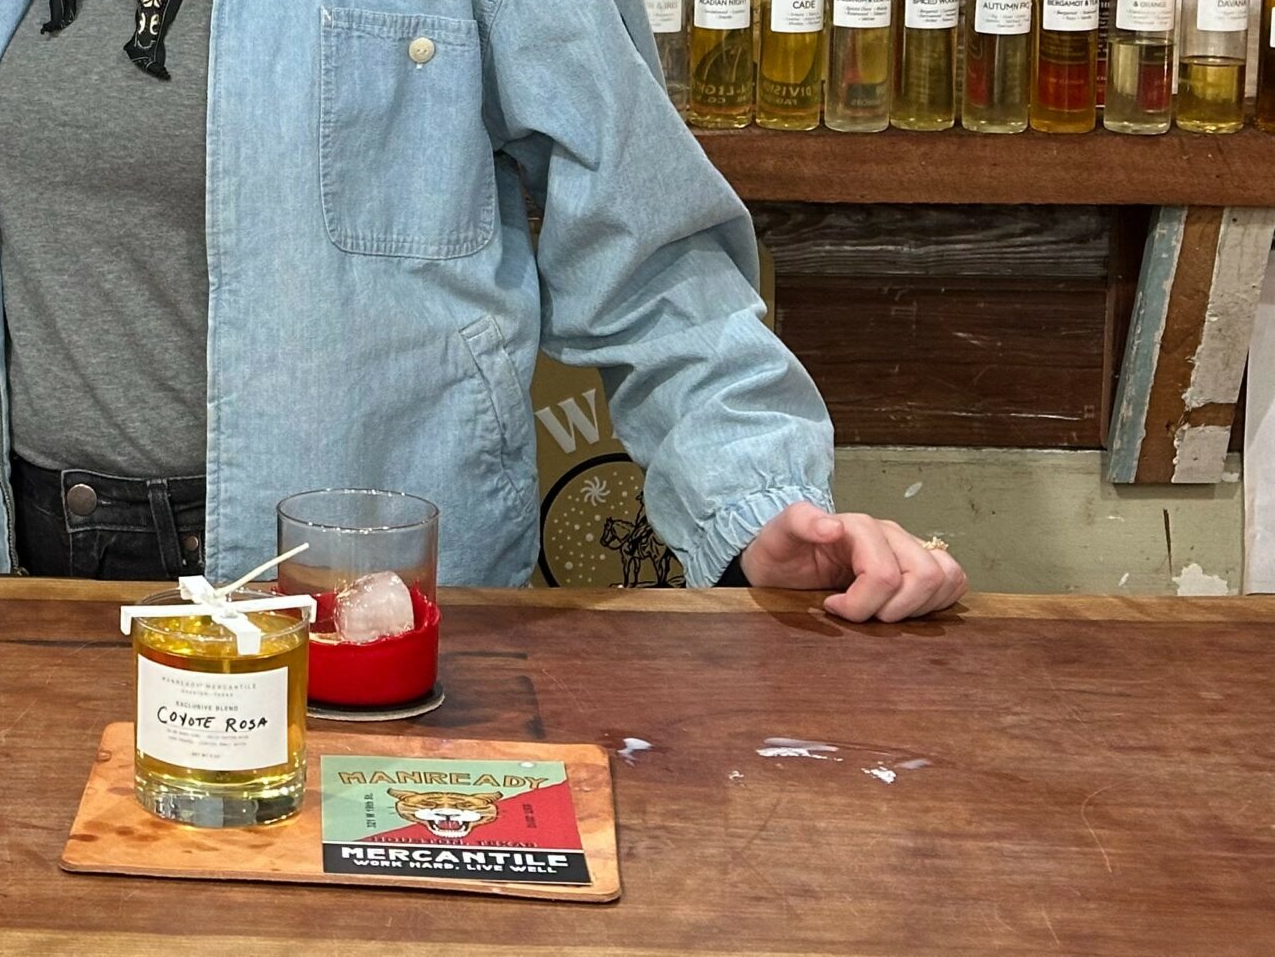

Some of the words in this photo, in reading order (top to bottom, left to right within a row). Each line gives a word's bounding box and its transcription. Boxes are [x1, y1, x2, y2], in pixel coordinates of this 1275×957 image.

[792, 0, 816, 10] CADE
[982, 2, 1019, 11] AUTUMN
[1046, 0, 1084, 7] BERGAMOT
[225, 717, 268, 733] ROSA
[338, 771, 550, 790] MANREADY
[340, 846, 570, 868] MERCANTILE
[353, 859, 403, 869] WORK
[409, 861, 461, 871] HARD.
[466, 863, 504, 872] LIVE
[509, 865, 557, 874] WELL
